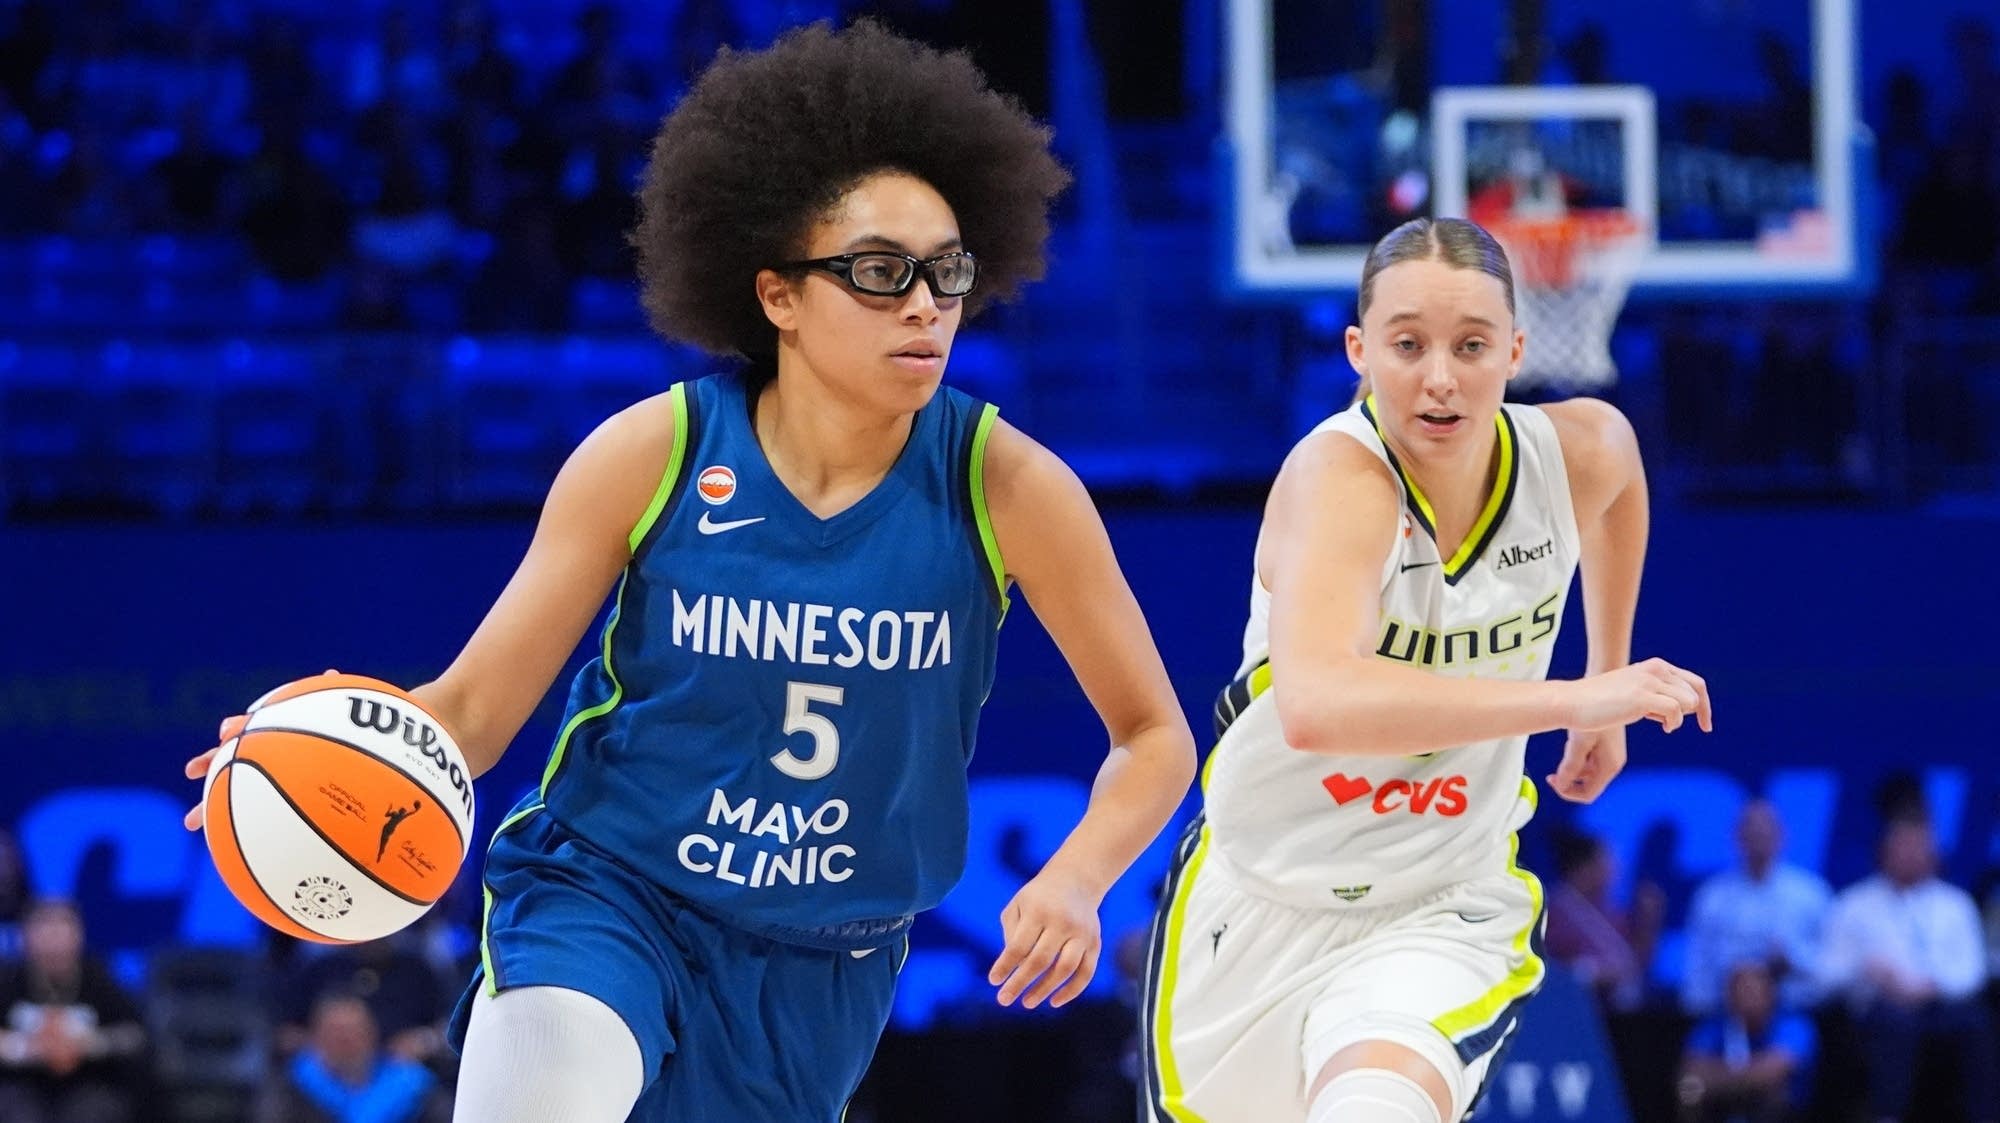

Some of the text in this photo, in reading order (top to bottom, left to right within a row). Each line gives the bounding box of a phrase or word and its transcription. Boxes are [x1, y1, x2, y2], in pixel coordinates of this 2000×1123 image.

[1497, 538, 1554, 571] Albert
[672, 588, 952, 671] MINNESOTA
[348, 694, 473, 820] Wilson
[770, 680, 845, 781] 5
[706, 787, 850, 845] MAYO
[1371, 775, 1469, 818] CVS
[677, 833, 857, 889] CLINIC
